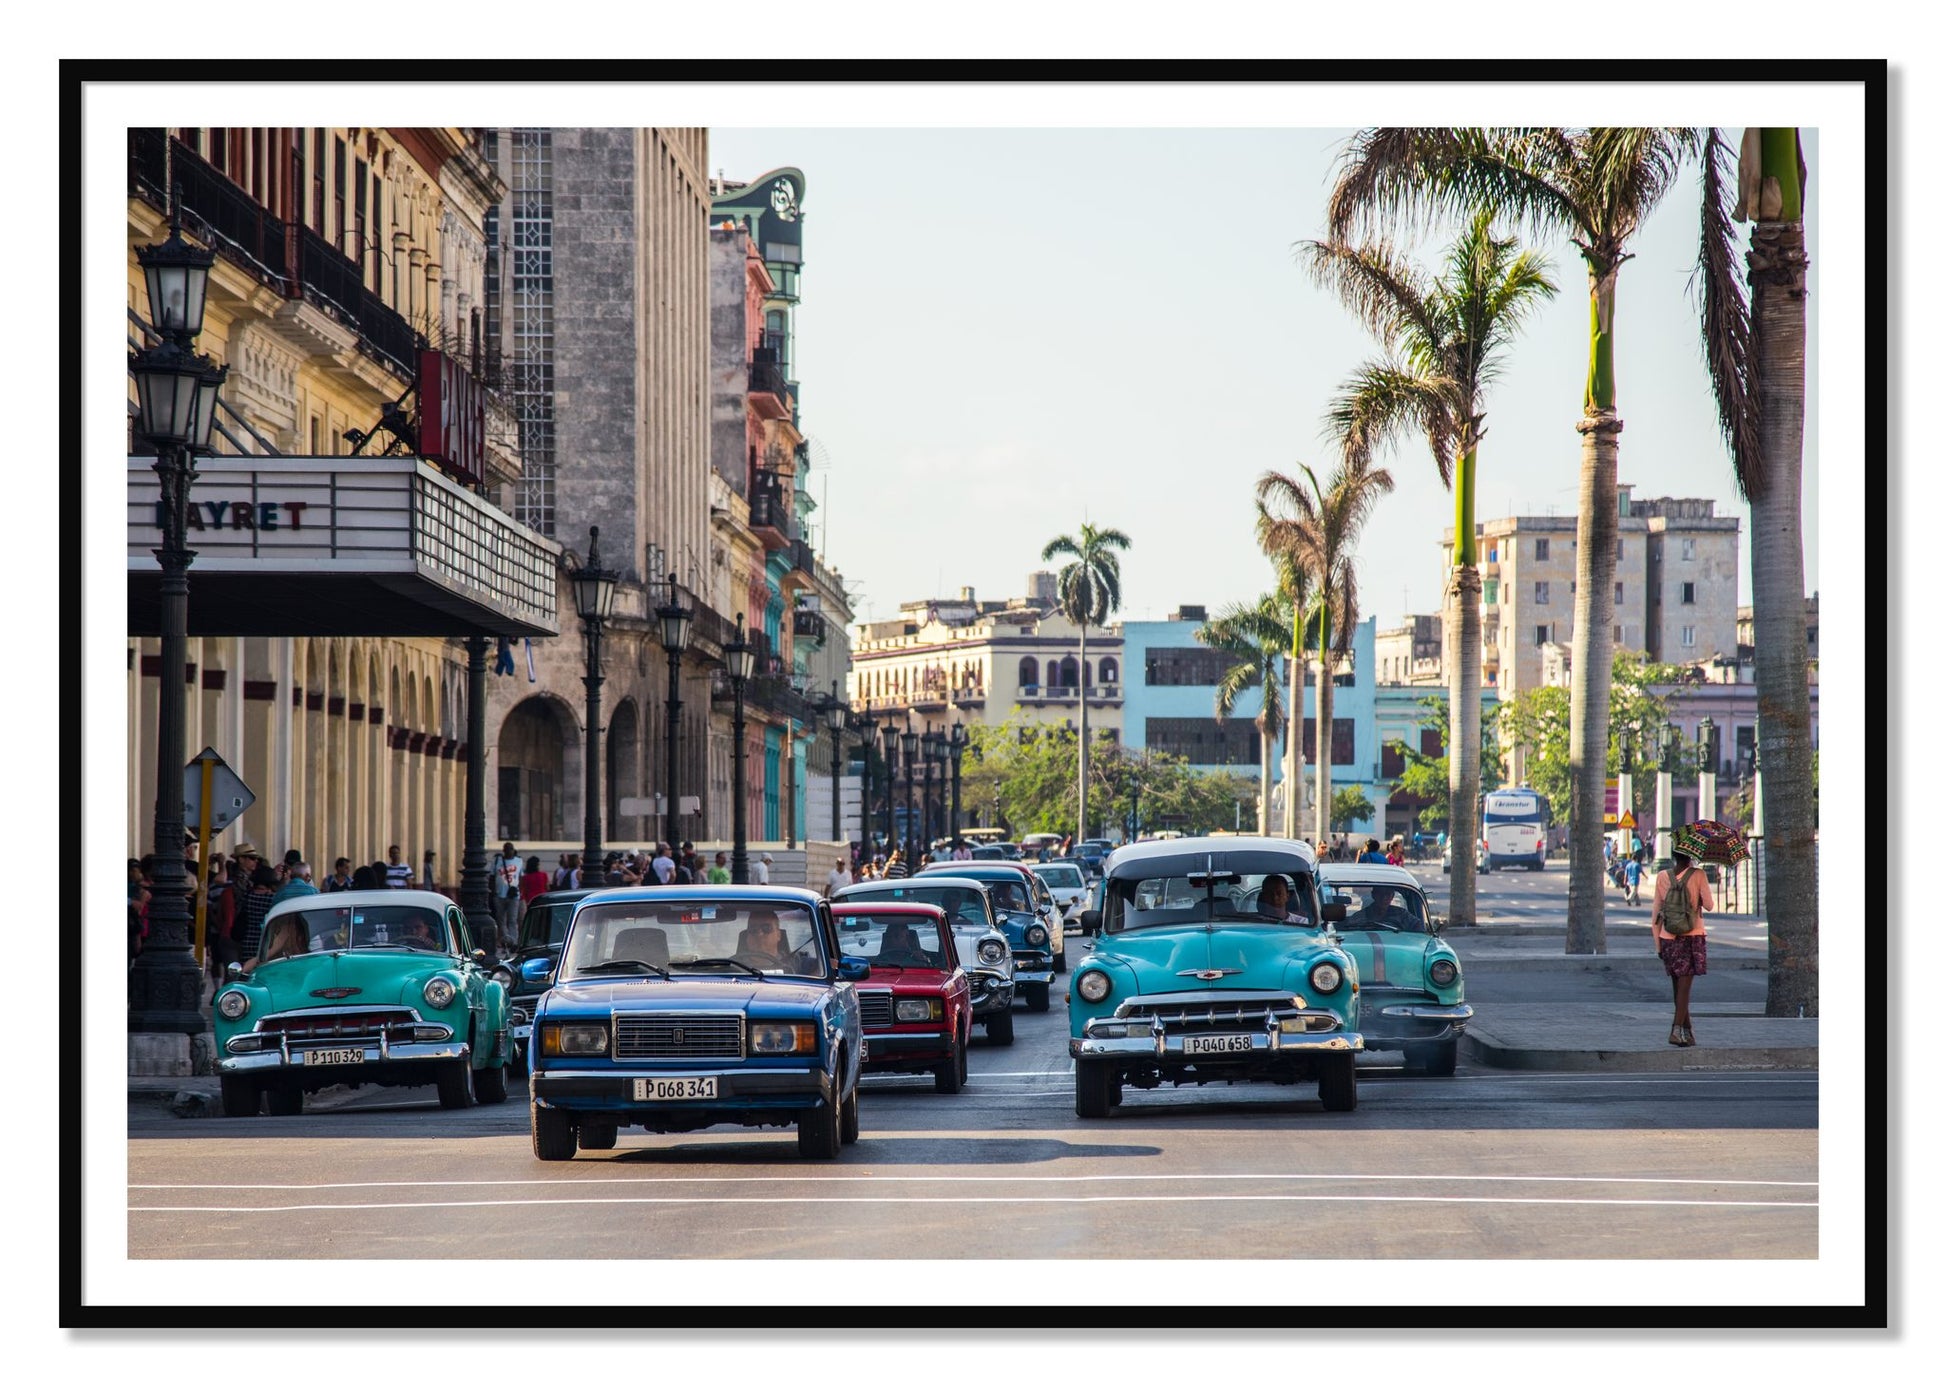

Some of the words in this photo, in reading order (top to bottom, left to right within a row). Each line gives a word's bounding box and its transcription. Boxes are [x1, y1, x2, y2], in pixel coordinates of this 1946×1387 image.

[1203, 1038, 1226, 1052] 040
[1228, 1036, 1250, 1050] 658
[321, 1052, 341, 1064] 110
[342, 1049, 363, 1063] 329
[645, 1079, 655, 1099] P
[657, 1081, 685, 1098] 068
[687, 1078, 715, 1097] 341
